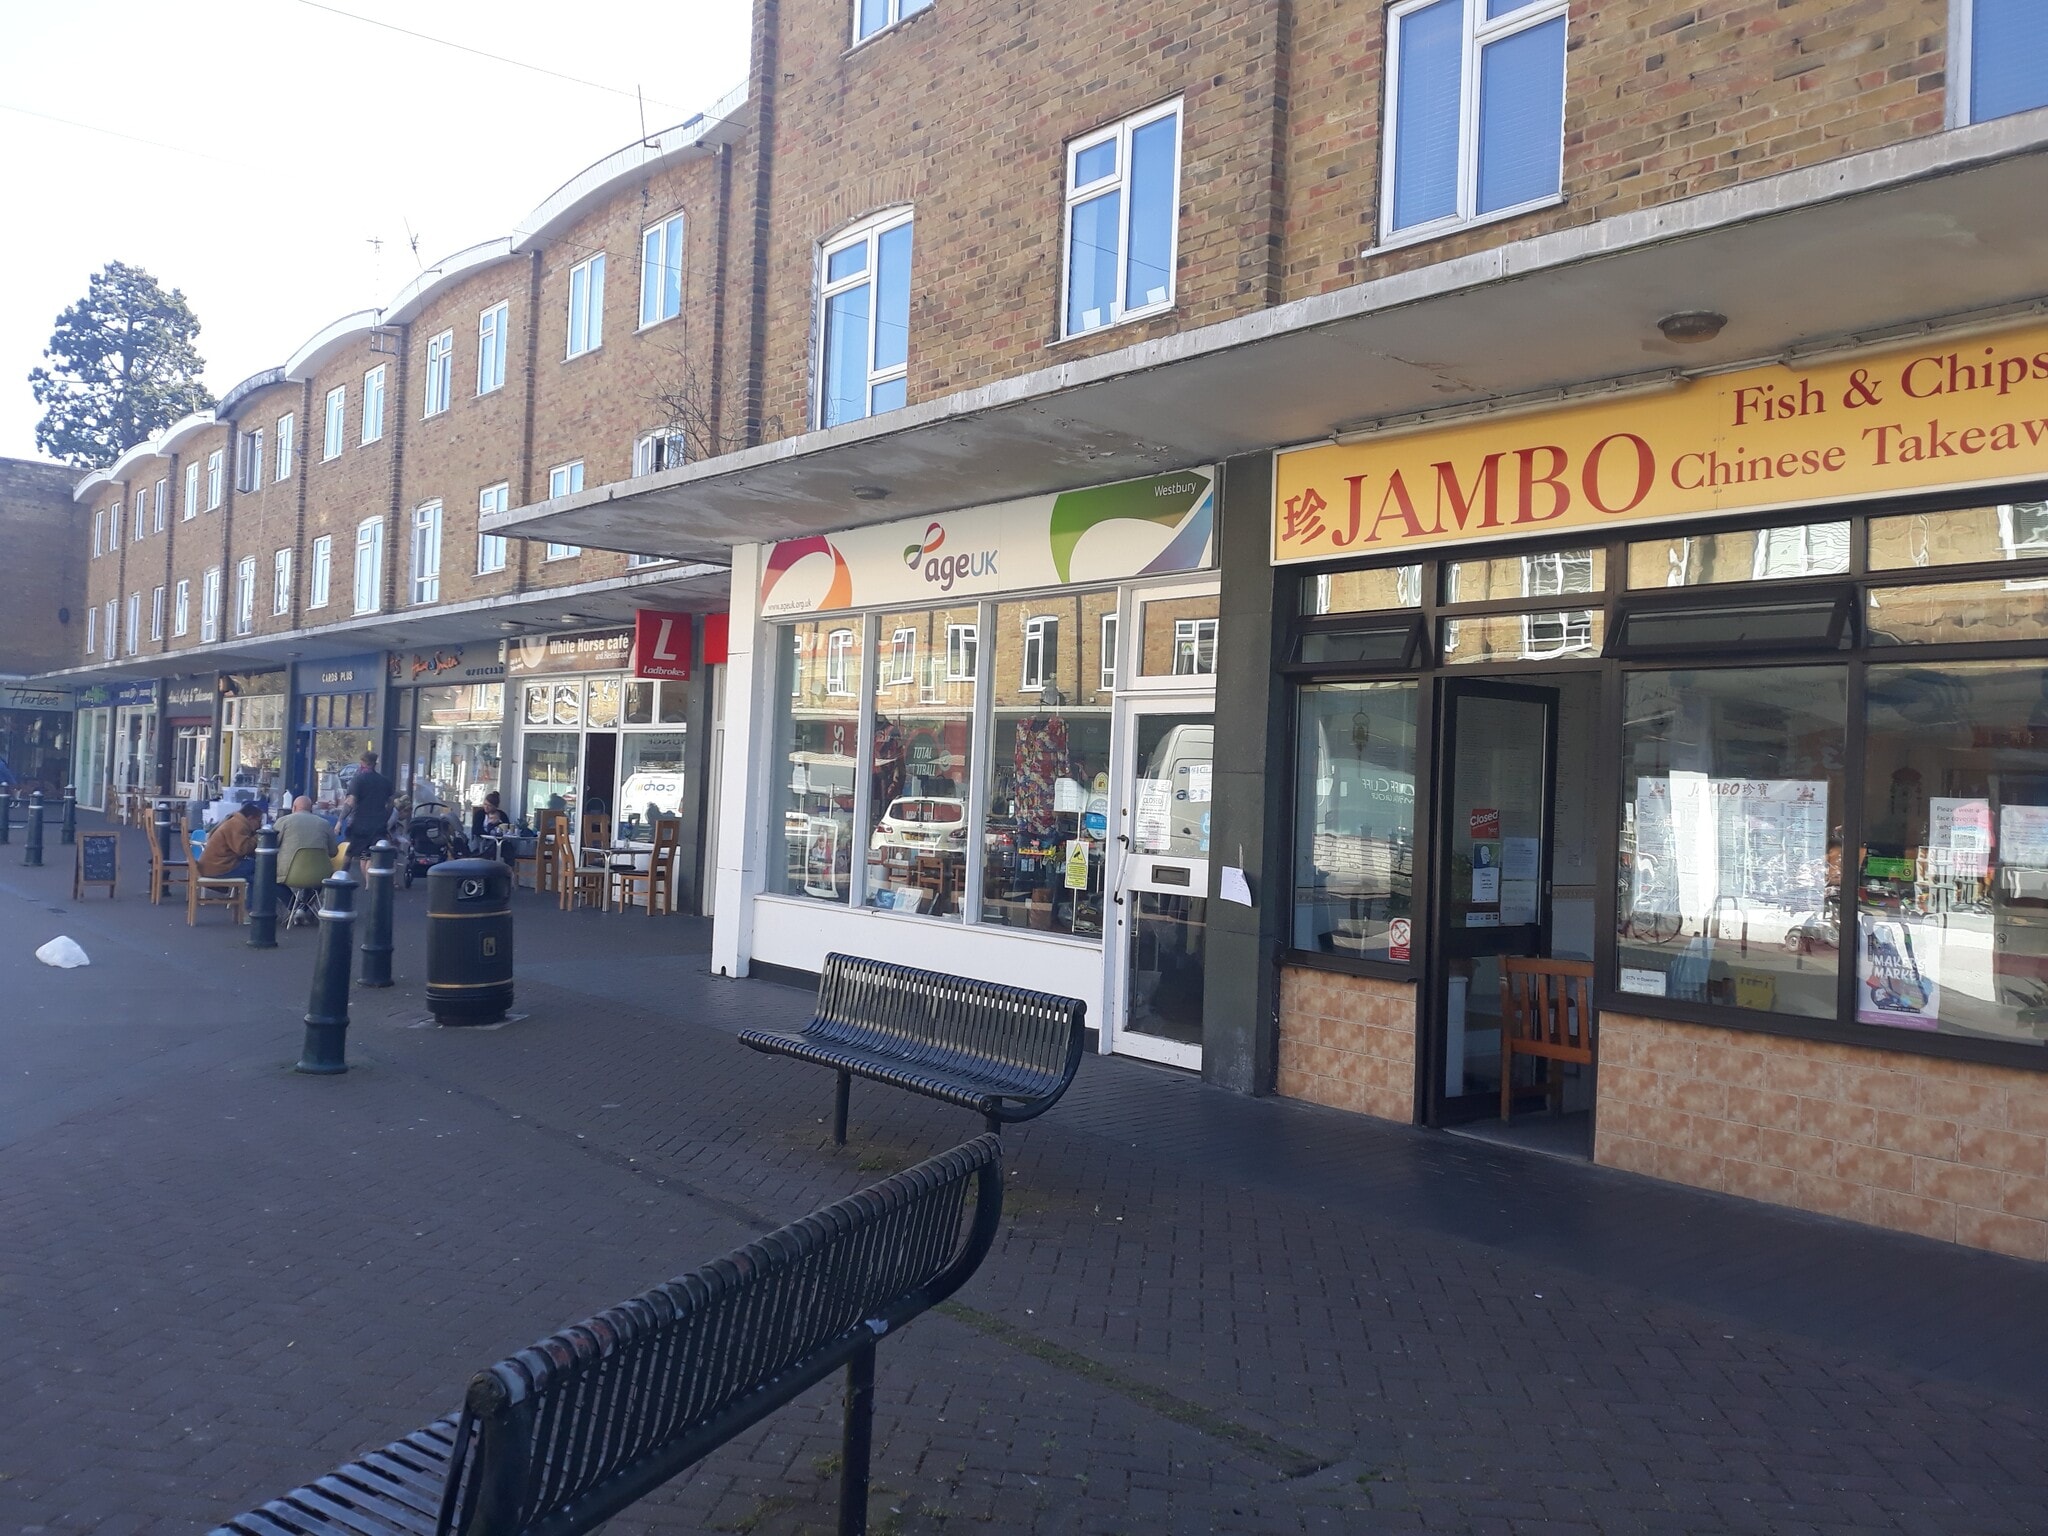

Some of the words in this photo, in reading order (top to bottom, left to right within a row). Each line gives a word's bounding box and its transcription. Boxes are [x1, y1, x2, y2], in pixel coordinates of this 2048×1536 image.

[1731, 378, 1826, 426] Fish
[1843, 368, 1884, 409] &
[1901, 346, 2048, 397] Chips
[1671, 447, 1846, 490] Chinese
[1154, 482, 1197, 497] Westbury
[1331, 432, 1656, 547] JAMBO
[1282, 487, 1328, 545] 珍
[549, 640, 575, 654] White
[577, 638, 604, 652] Horse
[607, 632, 629, 649] café
[321, 672, 338, 682] CARDS
[340, 671, 353, 681] PLUS
[643, 665, 686, 676] Ladbrokes
[913, 746, 932, 759] TOTAL
[1688, 782, 1740, 797] JMBO
[1469, 808, 1499, 827] Closed
